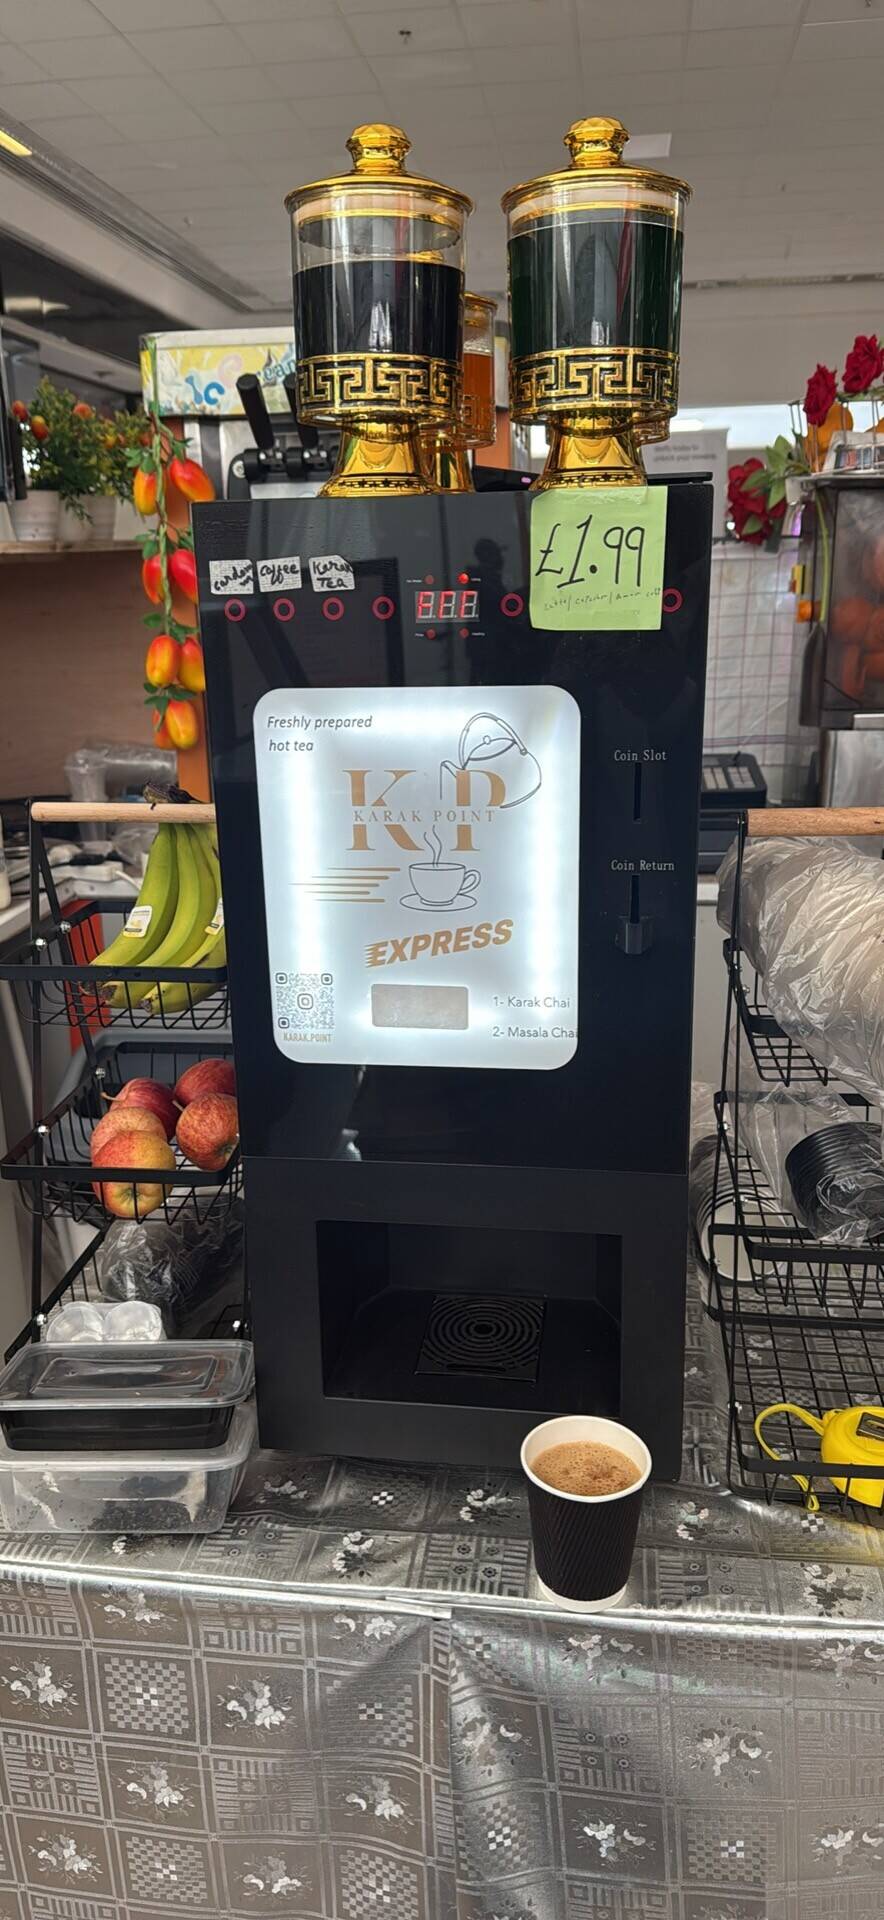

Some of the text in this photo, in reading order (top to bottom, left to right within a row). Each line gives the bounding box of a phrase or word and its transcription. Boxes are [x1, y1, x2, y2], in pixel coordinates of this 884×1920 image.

[535, 514, 645, 589] £1.99
[267, 715, 373, 731] Freshly prepared
[269, 739, 314, 752] hot tea
[614, 749, 667, 761] Coin Slot
[354, 809, 496, 823] KARAK POINT
[610, 859, 675, 871] Coin Return
[364, 918, 514, 969] EXPRESS
[507, 996, 541, 1008] Karak
[543, 996, 570, 1008] Chai
[507, 1026, 549, 1038] Masala
